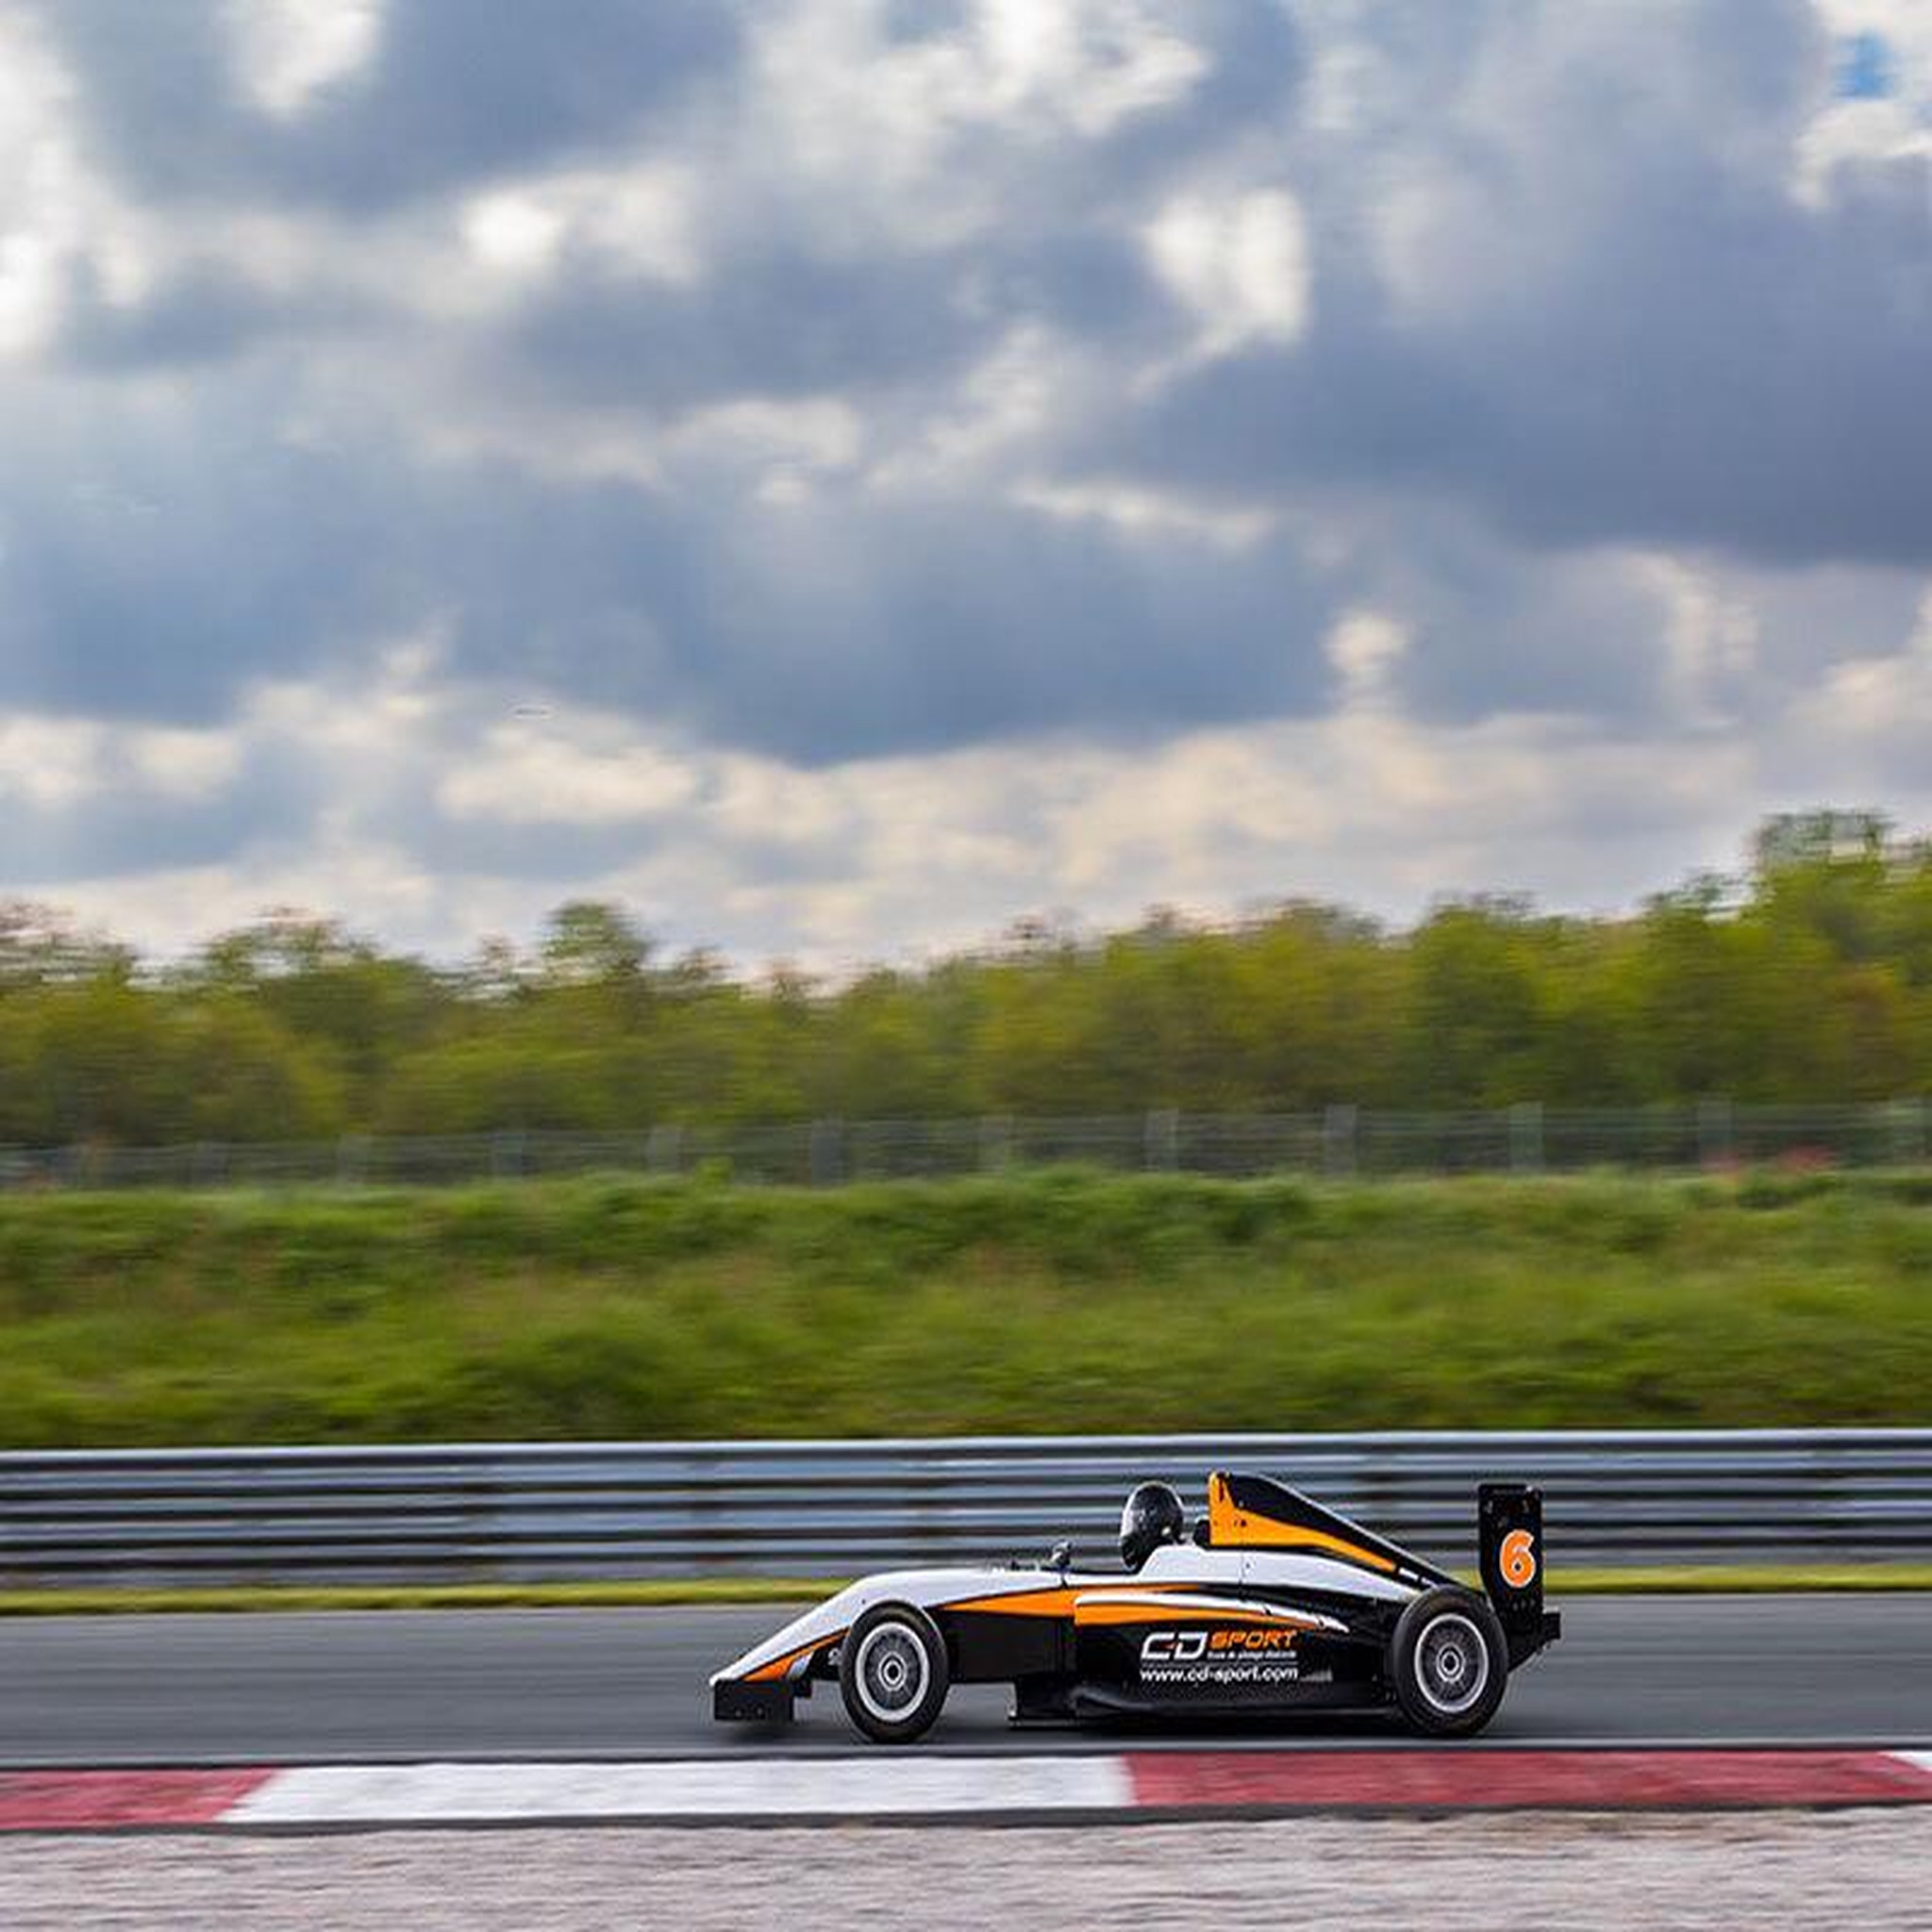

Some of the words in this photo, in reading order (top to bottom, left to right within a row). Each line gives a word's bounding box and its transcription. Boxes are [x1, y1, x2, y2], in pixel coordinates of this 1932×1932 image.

[1500, 1529, 1536, 1588] 6
[1141, 1631, 1208, 1660] CD
[1210, 1629, 1298, 1649] SPORT
[1140, 1667, 1299, 1683] www.cd-sport.com
